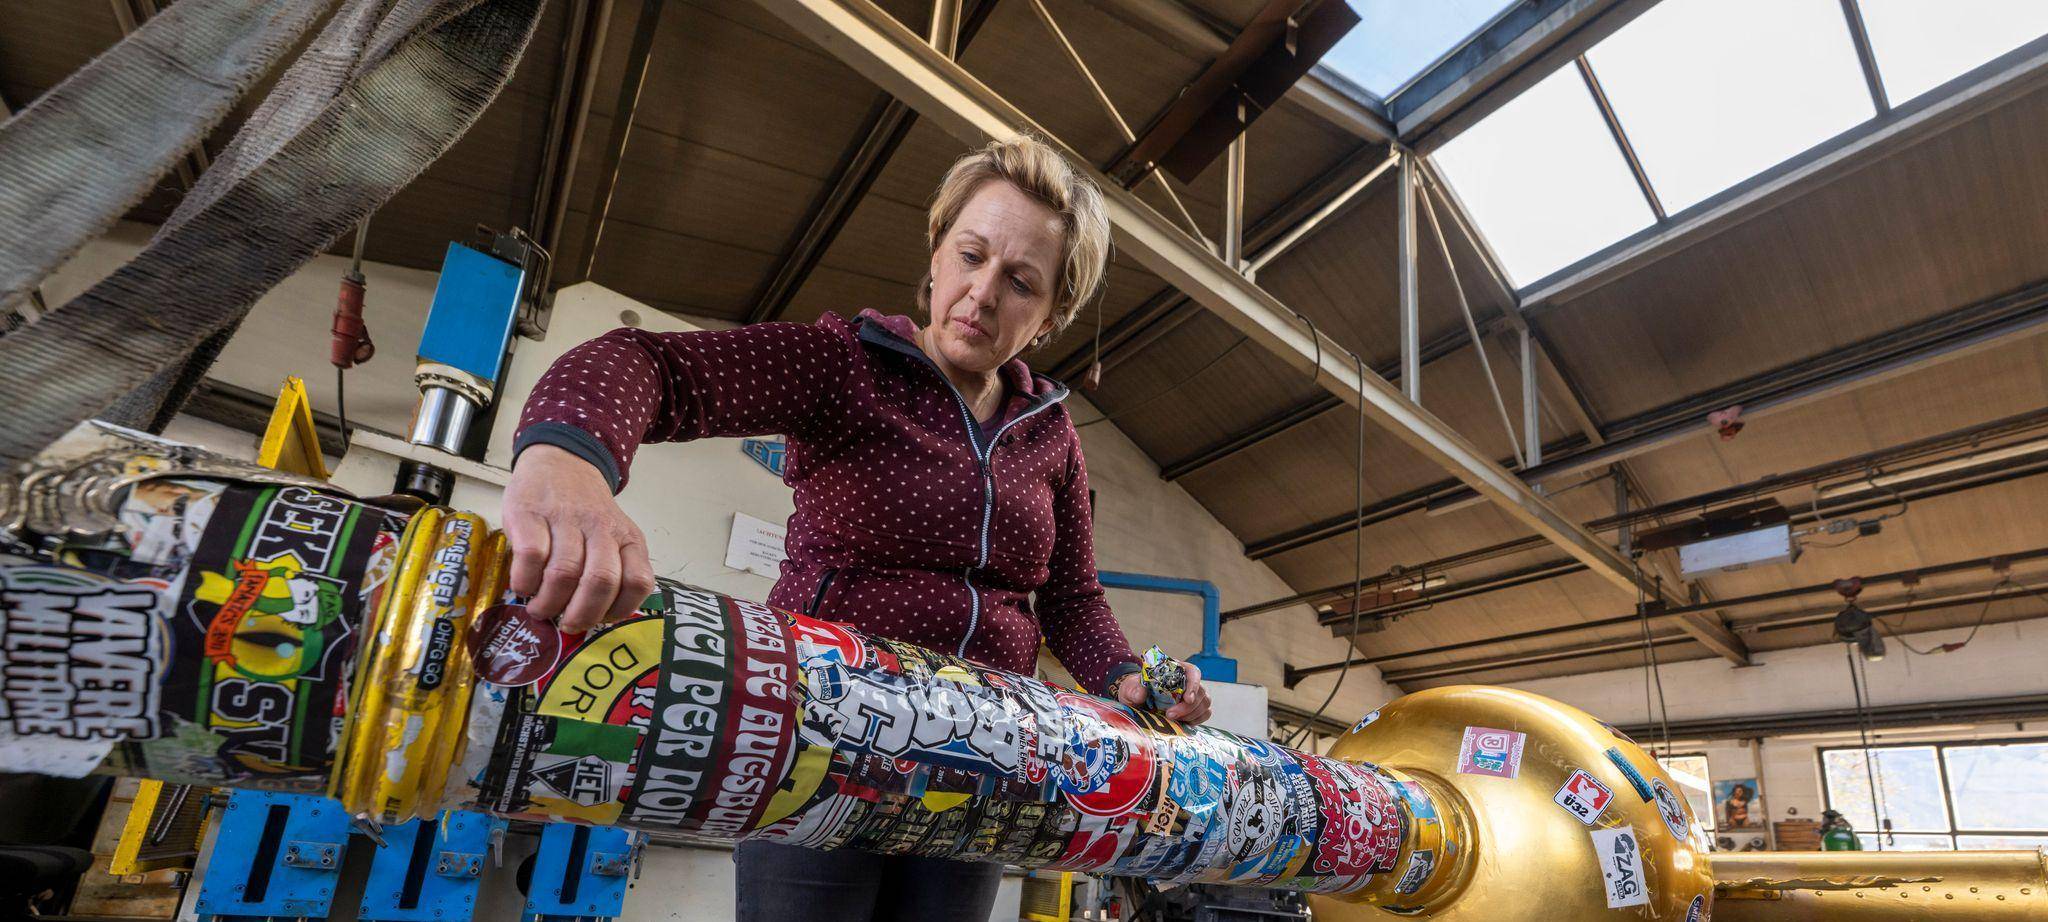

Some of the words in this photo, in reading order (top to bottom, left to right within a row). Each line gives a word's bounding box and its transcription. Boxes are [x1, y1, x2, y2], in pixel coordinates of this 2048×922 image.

[248, 486, 349, 573] SEK
[735, 600, 787, 653] ORZA
[560, 643, 638, 720] DOR
[745, 656, 788, 701] FC
[656, 672, 723, 758] PER
[574, 756, 605, 804] HEC
[1563, 793, 1589, 818] Ü32
[1615, 853, 1638, 896] ZAG
[1690, 899, 1702, 922] SMIL
